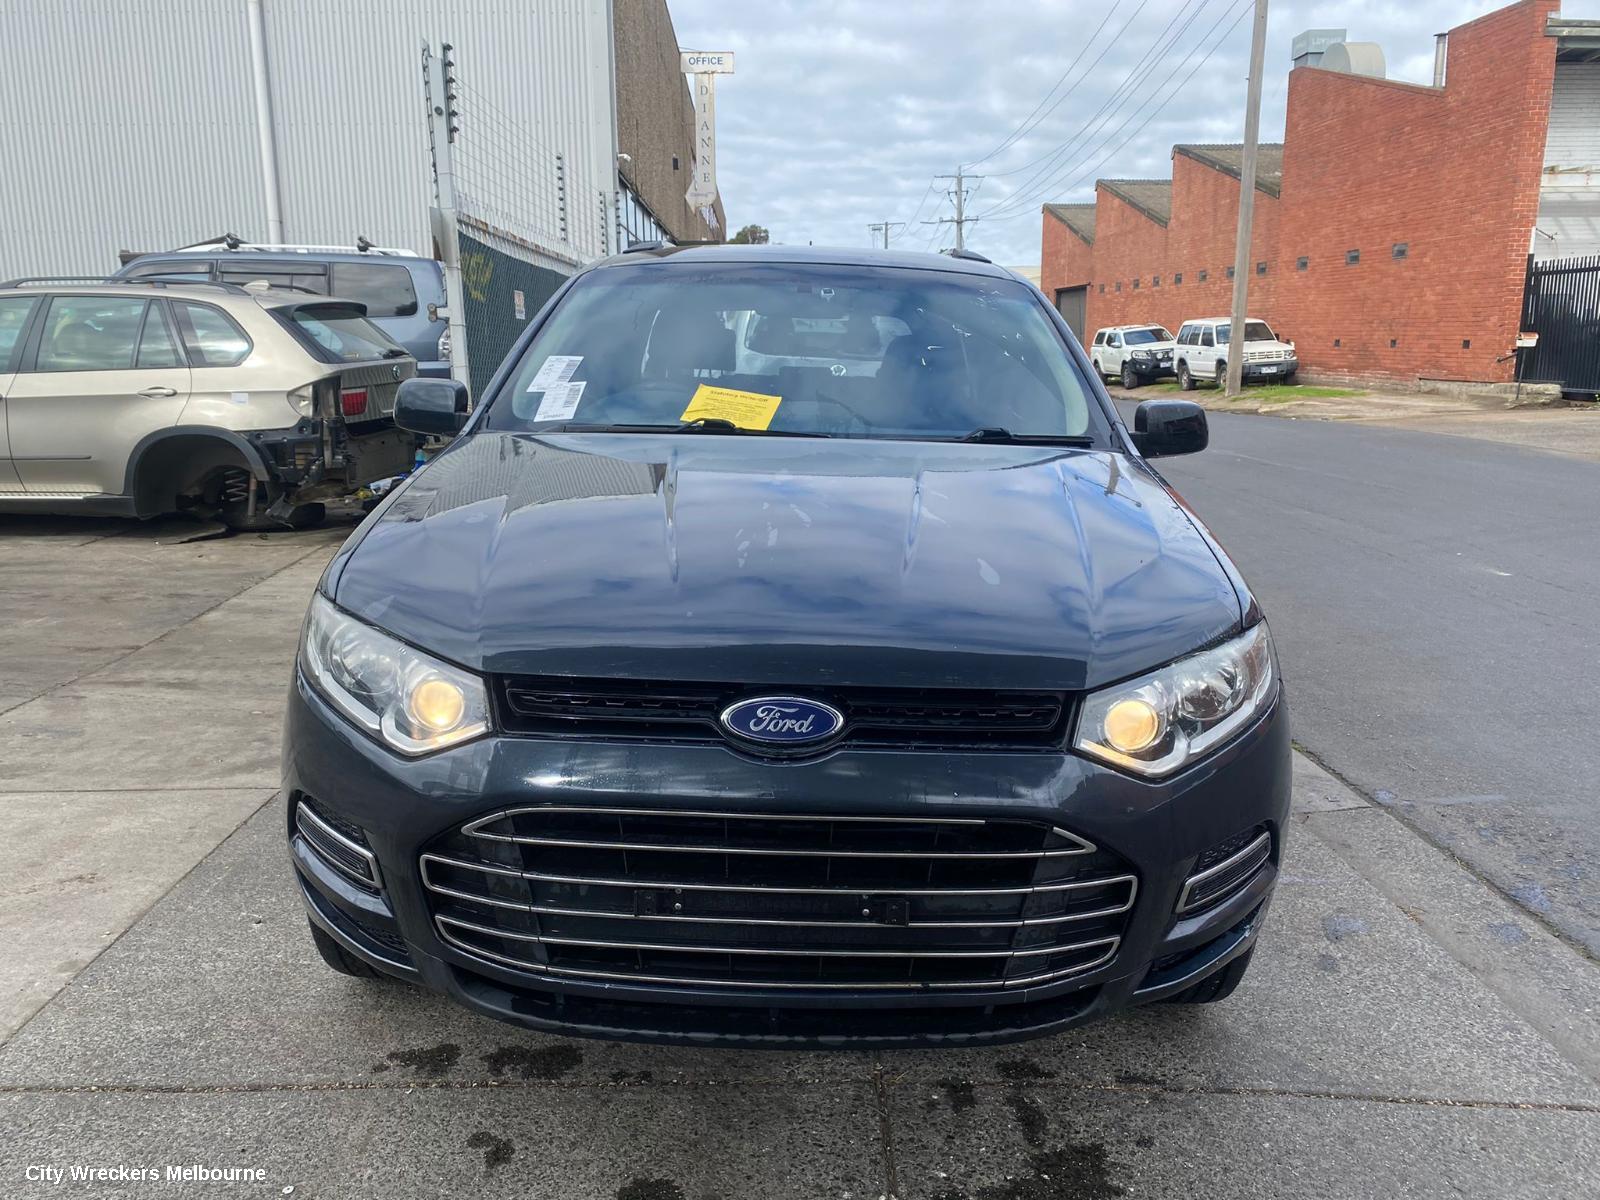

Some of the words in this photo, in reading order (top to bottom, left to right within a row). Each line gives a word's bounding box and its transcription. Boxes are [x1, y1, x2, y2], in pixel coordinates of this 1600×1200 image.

[688, 56, 723, 66] OFFICE
[699, 85, 712, 183] DIANNE
[749, 705, 815, 733] Ford
